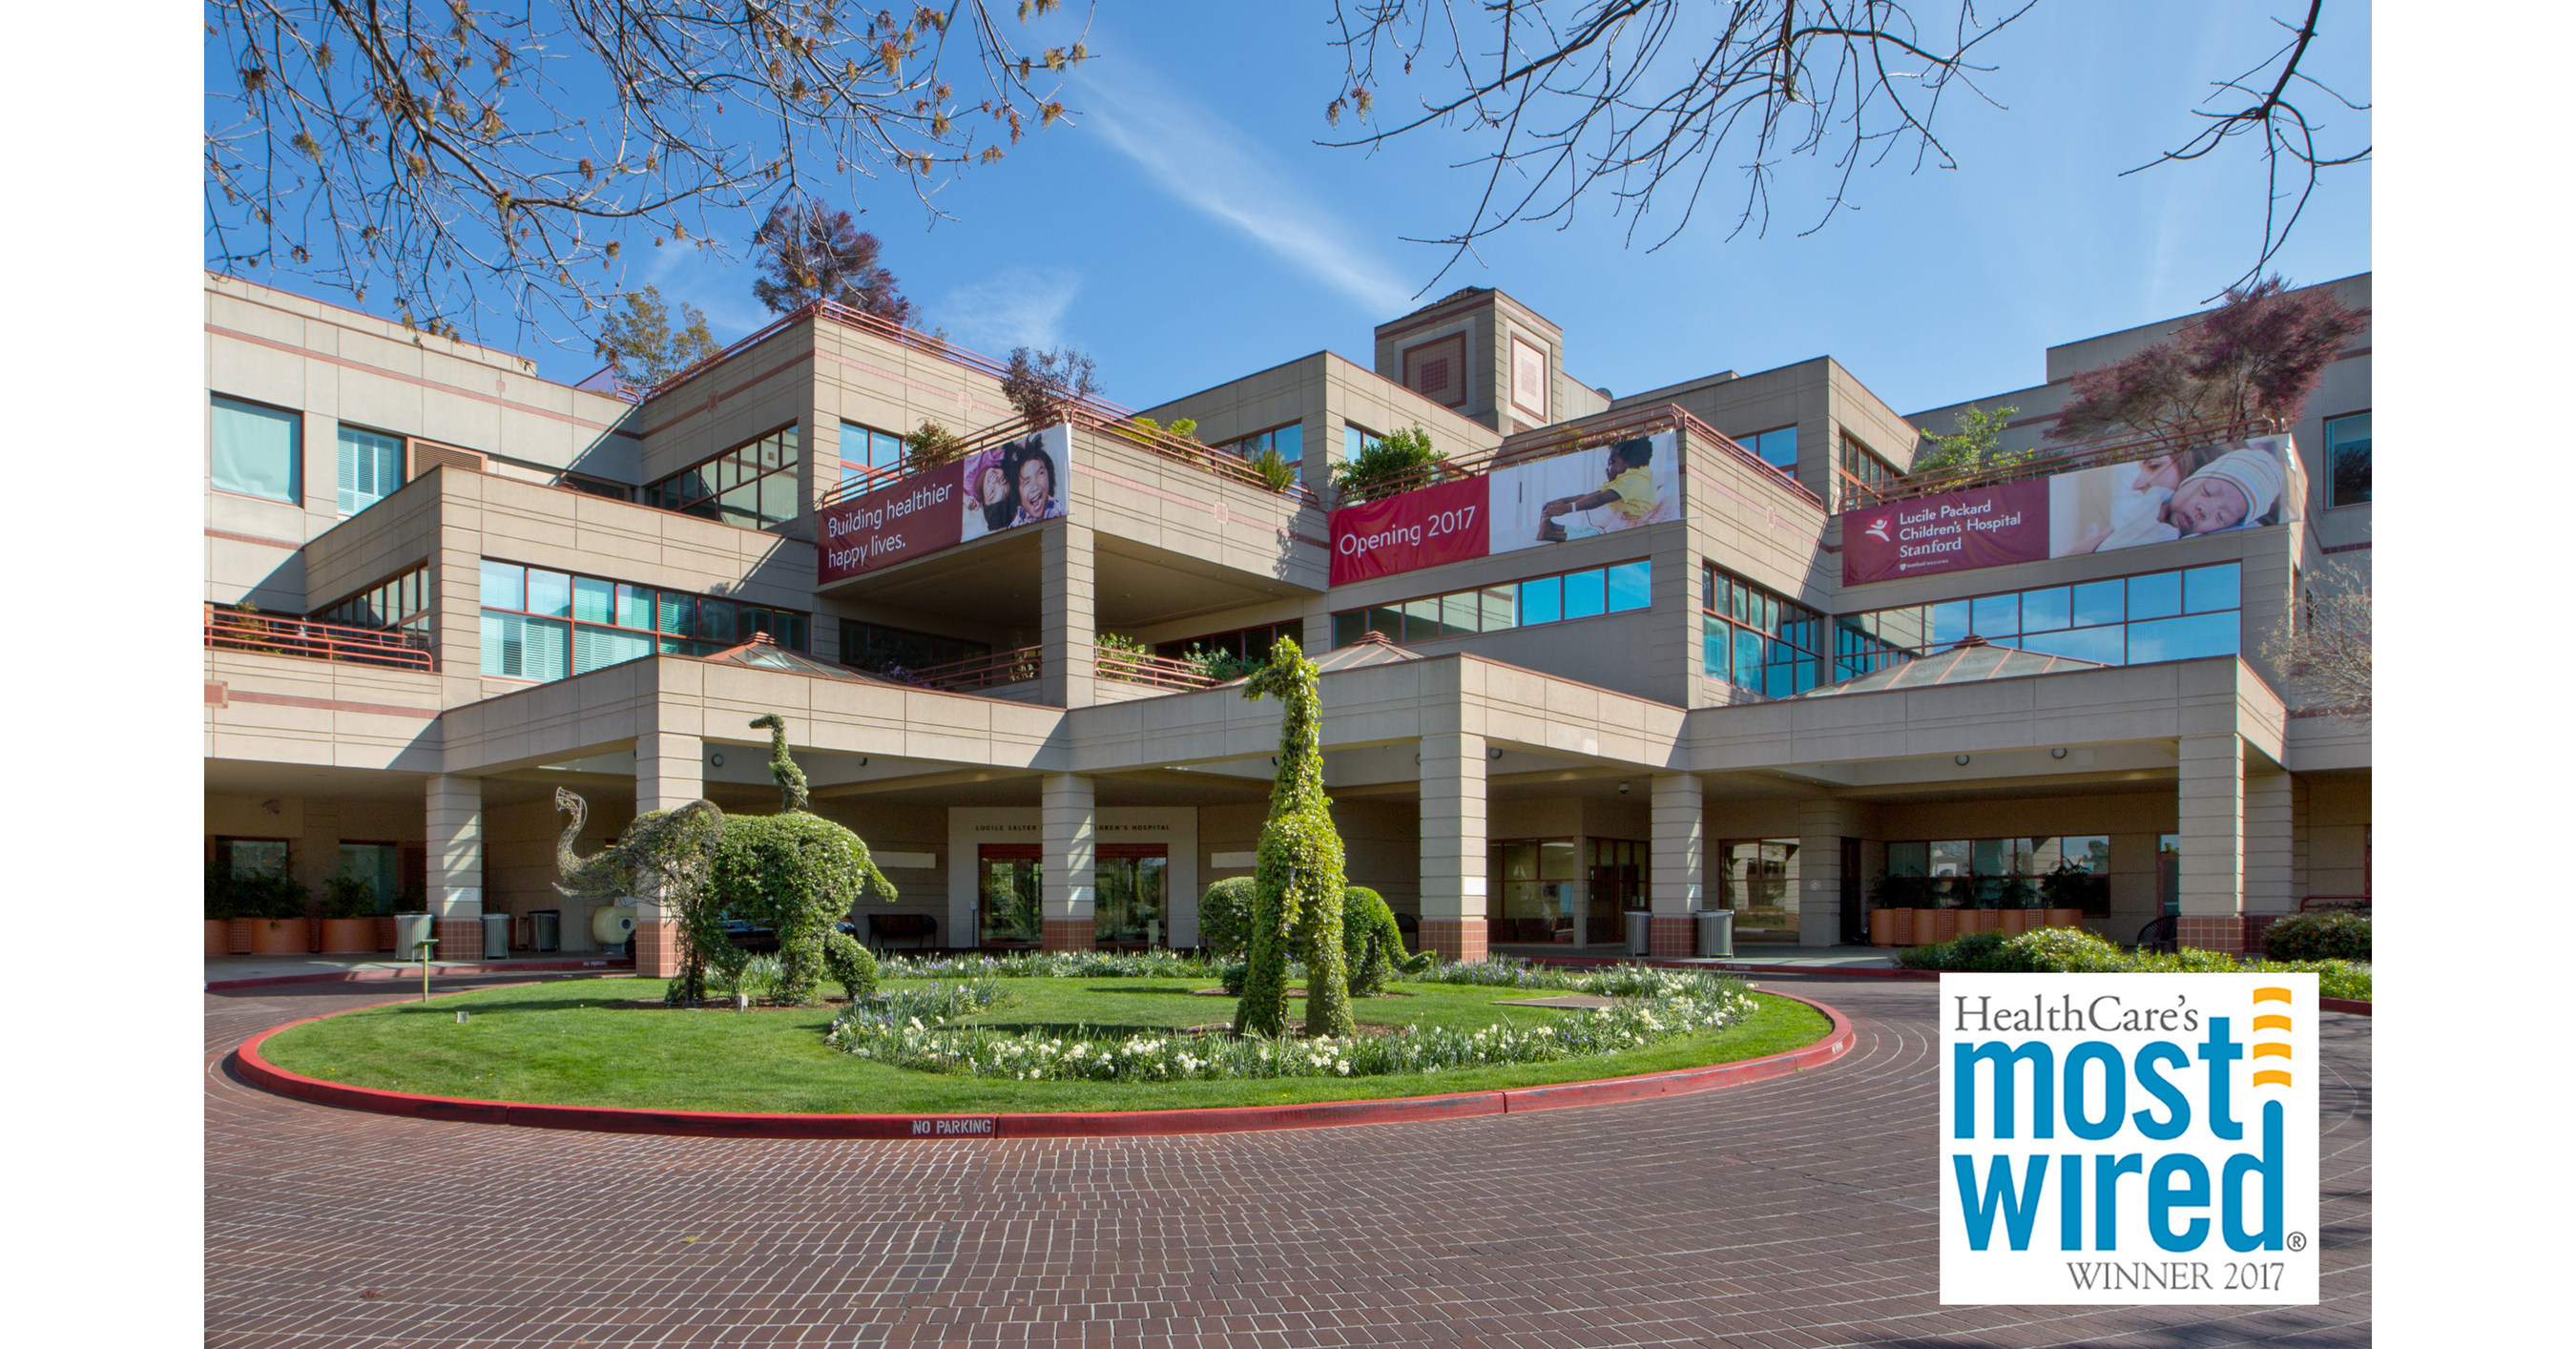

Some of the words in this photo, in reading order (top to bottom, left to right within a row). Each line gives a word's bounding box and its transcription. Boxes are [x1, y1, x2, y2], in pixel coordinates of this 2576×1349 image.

[828, 508, 883, 538] Building
[886, 483, 952, 521] healthier
[1900, 508, 1936, 526] Lucile
[1941, 499, 1991, 519] Packard
[1340, 524, 1421, 558] Opening
[1428, 506, 1476, 537] 2017
[1900, 523, 1962, 541] Children's
[1966, 511, 2021, 533] Hospital
[828, 544, 868, 571] happy
[871, 532, 906, 556] lives.
[1900, 537, 1962, 558] Stanford
[912, 1120, 931, 1134] NO
[936, 1120, 991, 1134] PARKING
